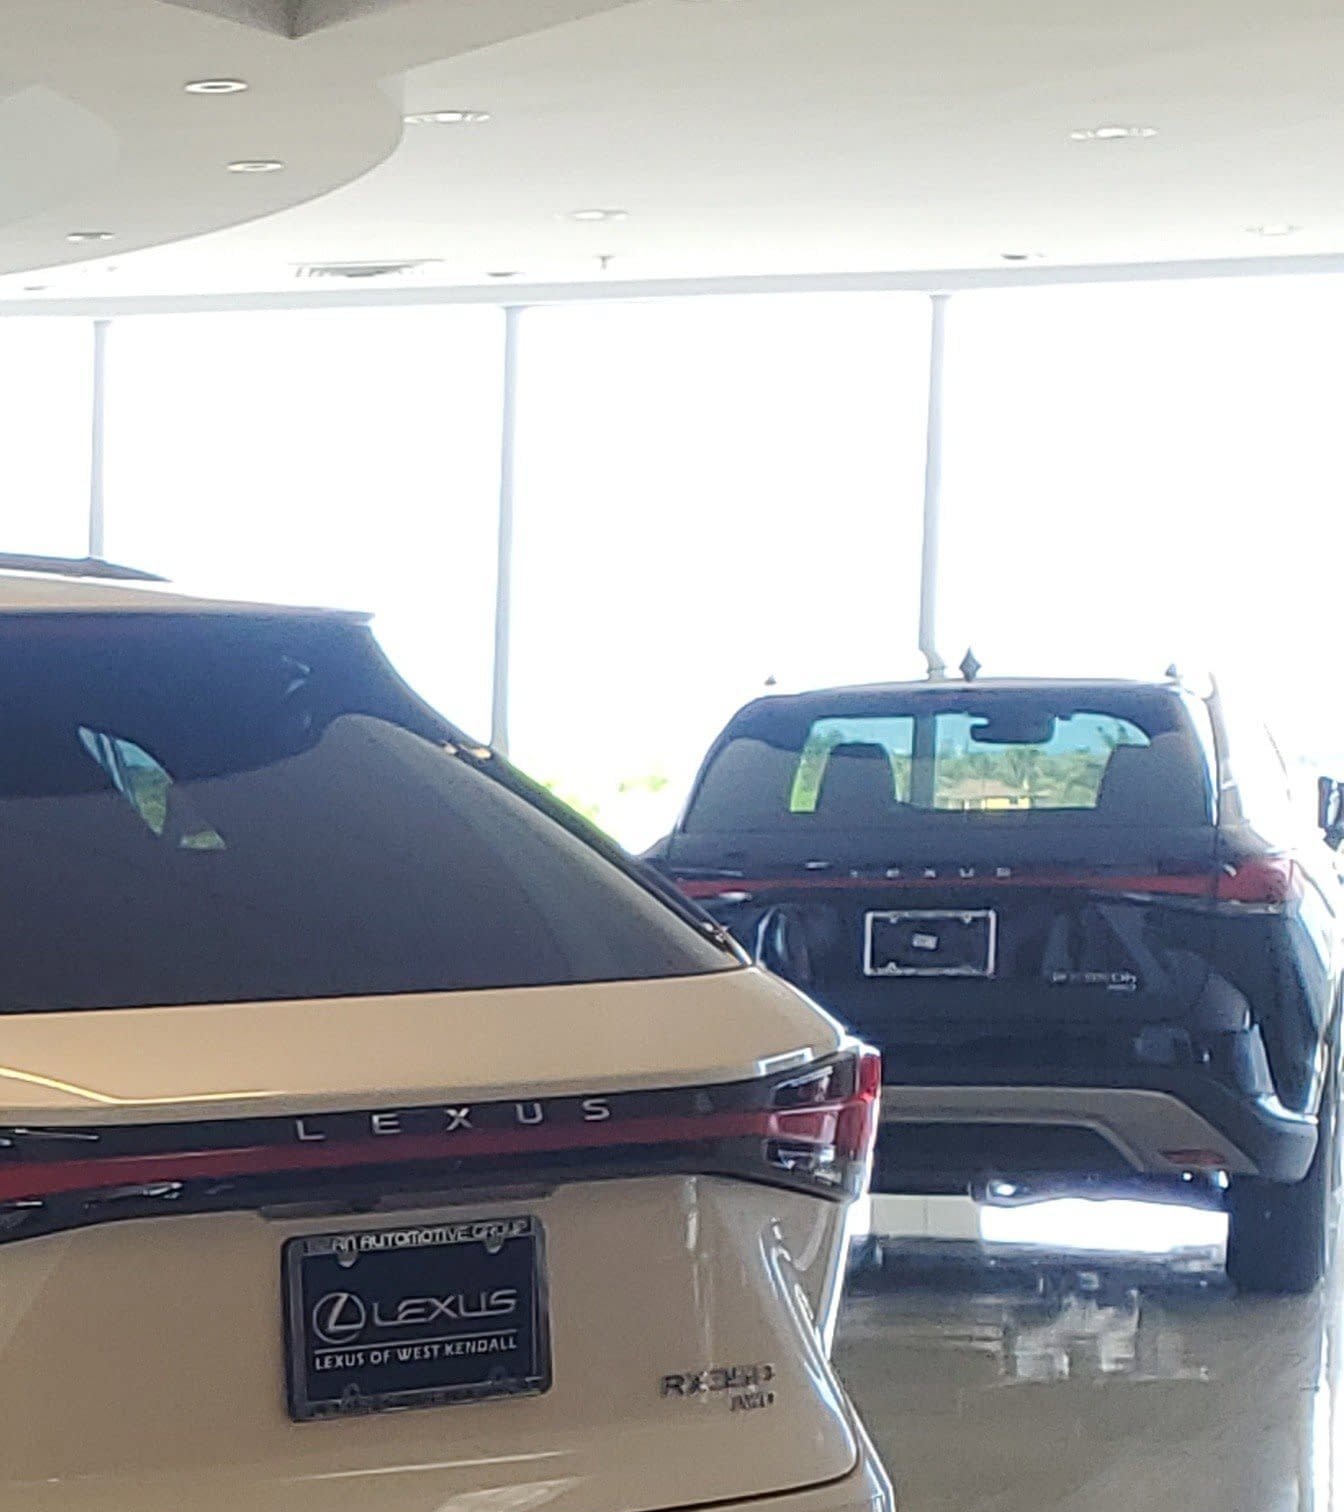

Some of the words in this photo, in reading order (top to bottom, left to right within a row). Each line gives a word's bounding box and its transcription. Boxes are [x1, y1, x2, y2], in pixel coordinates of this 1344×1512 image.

[295, 1098, 611, 1141] LEXUS
[361, 1222, 469, 1250] AUTOMOTIVE
[373, 1289, 518, 1328] LEXUS
[315, 1351, 365, 1372] LEXUS
[370, 1349, 391, 1365] OF
[396, 1343, 440, 1362] WEST
[444, 1336, 518, 1358] KENDALL
